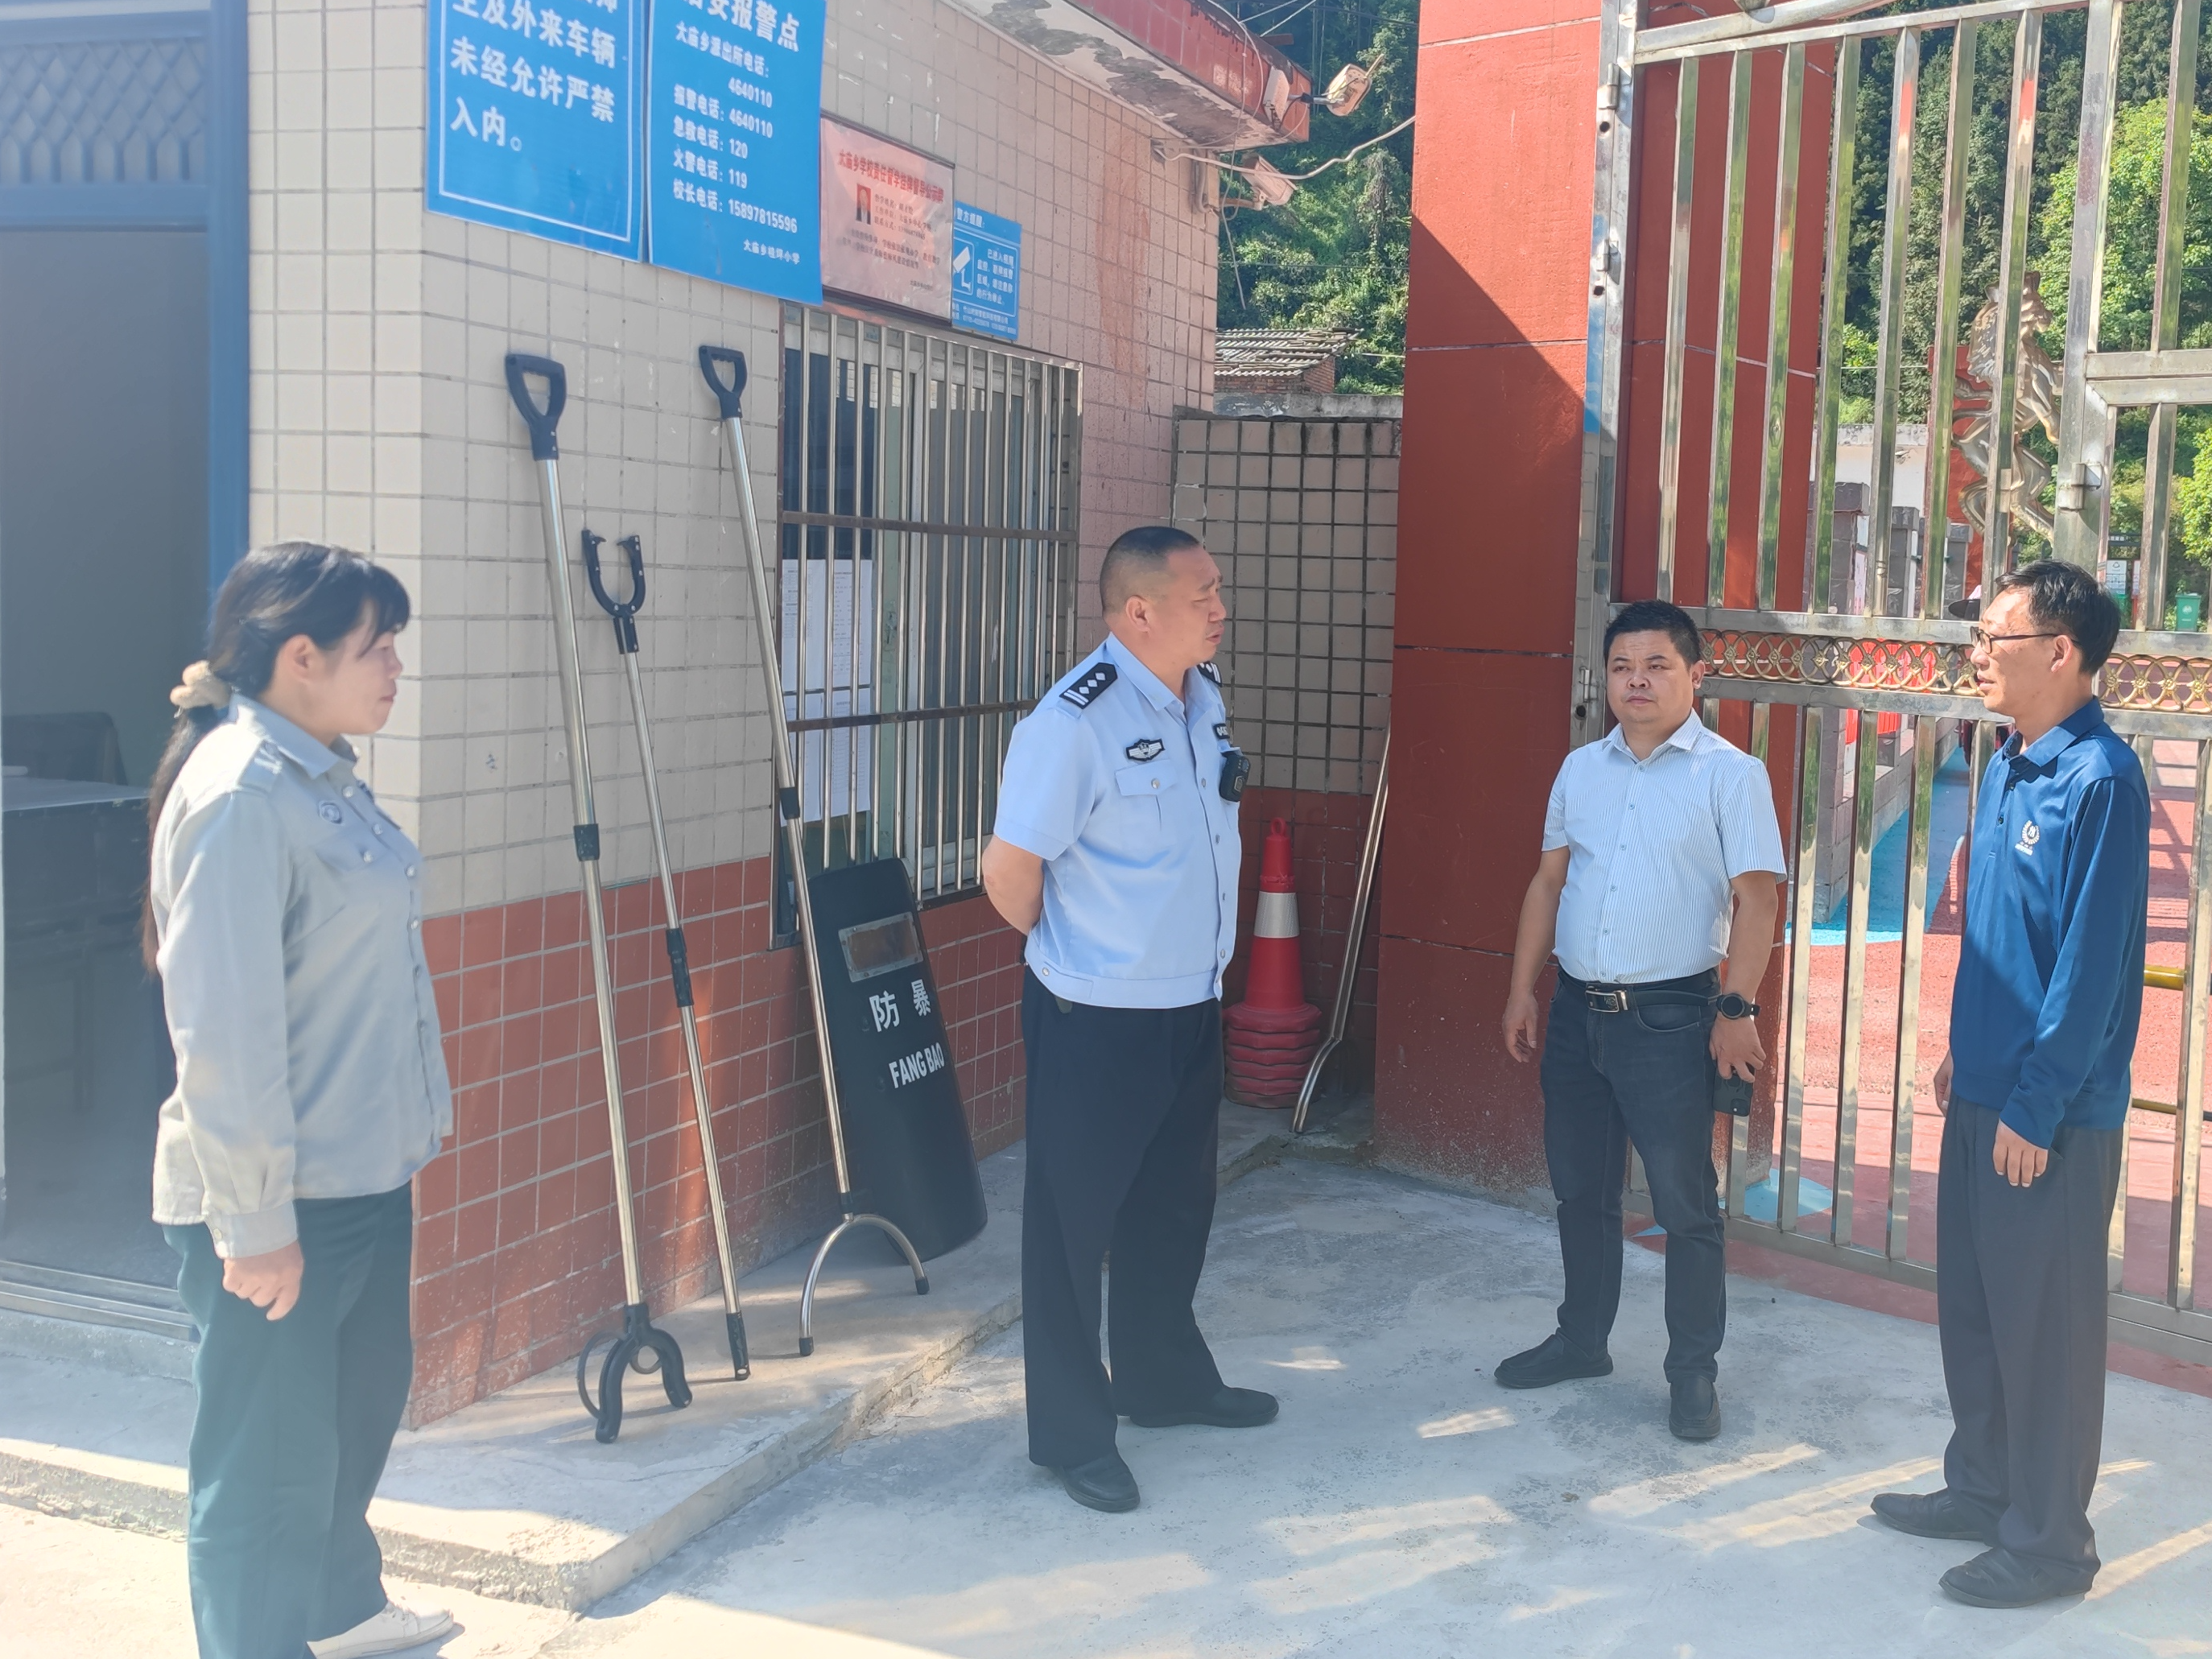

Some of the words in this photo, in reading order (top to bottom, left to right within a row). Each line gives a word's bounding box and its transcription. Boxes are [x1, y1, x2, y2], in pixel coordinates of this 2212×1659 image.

[450, 35, 615, 123] 未经允许严禁
[728, 76, 773, 109] 4640110
[450, 96, 522, 152] 入内。
[869, 978, 931, 1033] 防暴
[888, 1050, 928, 1089] FANG
[924, 1042, 945, 1073] BAO
